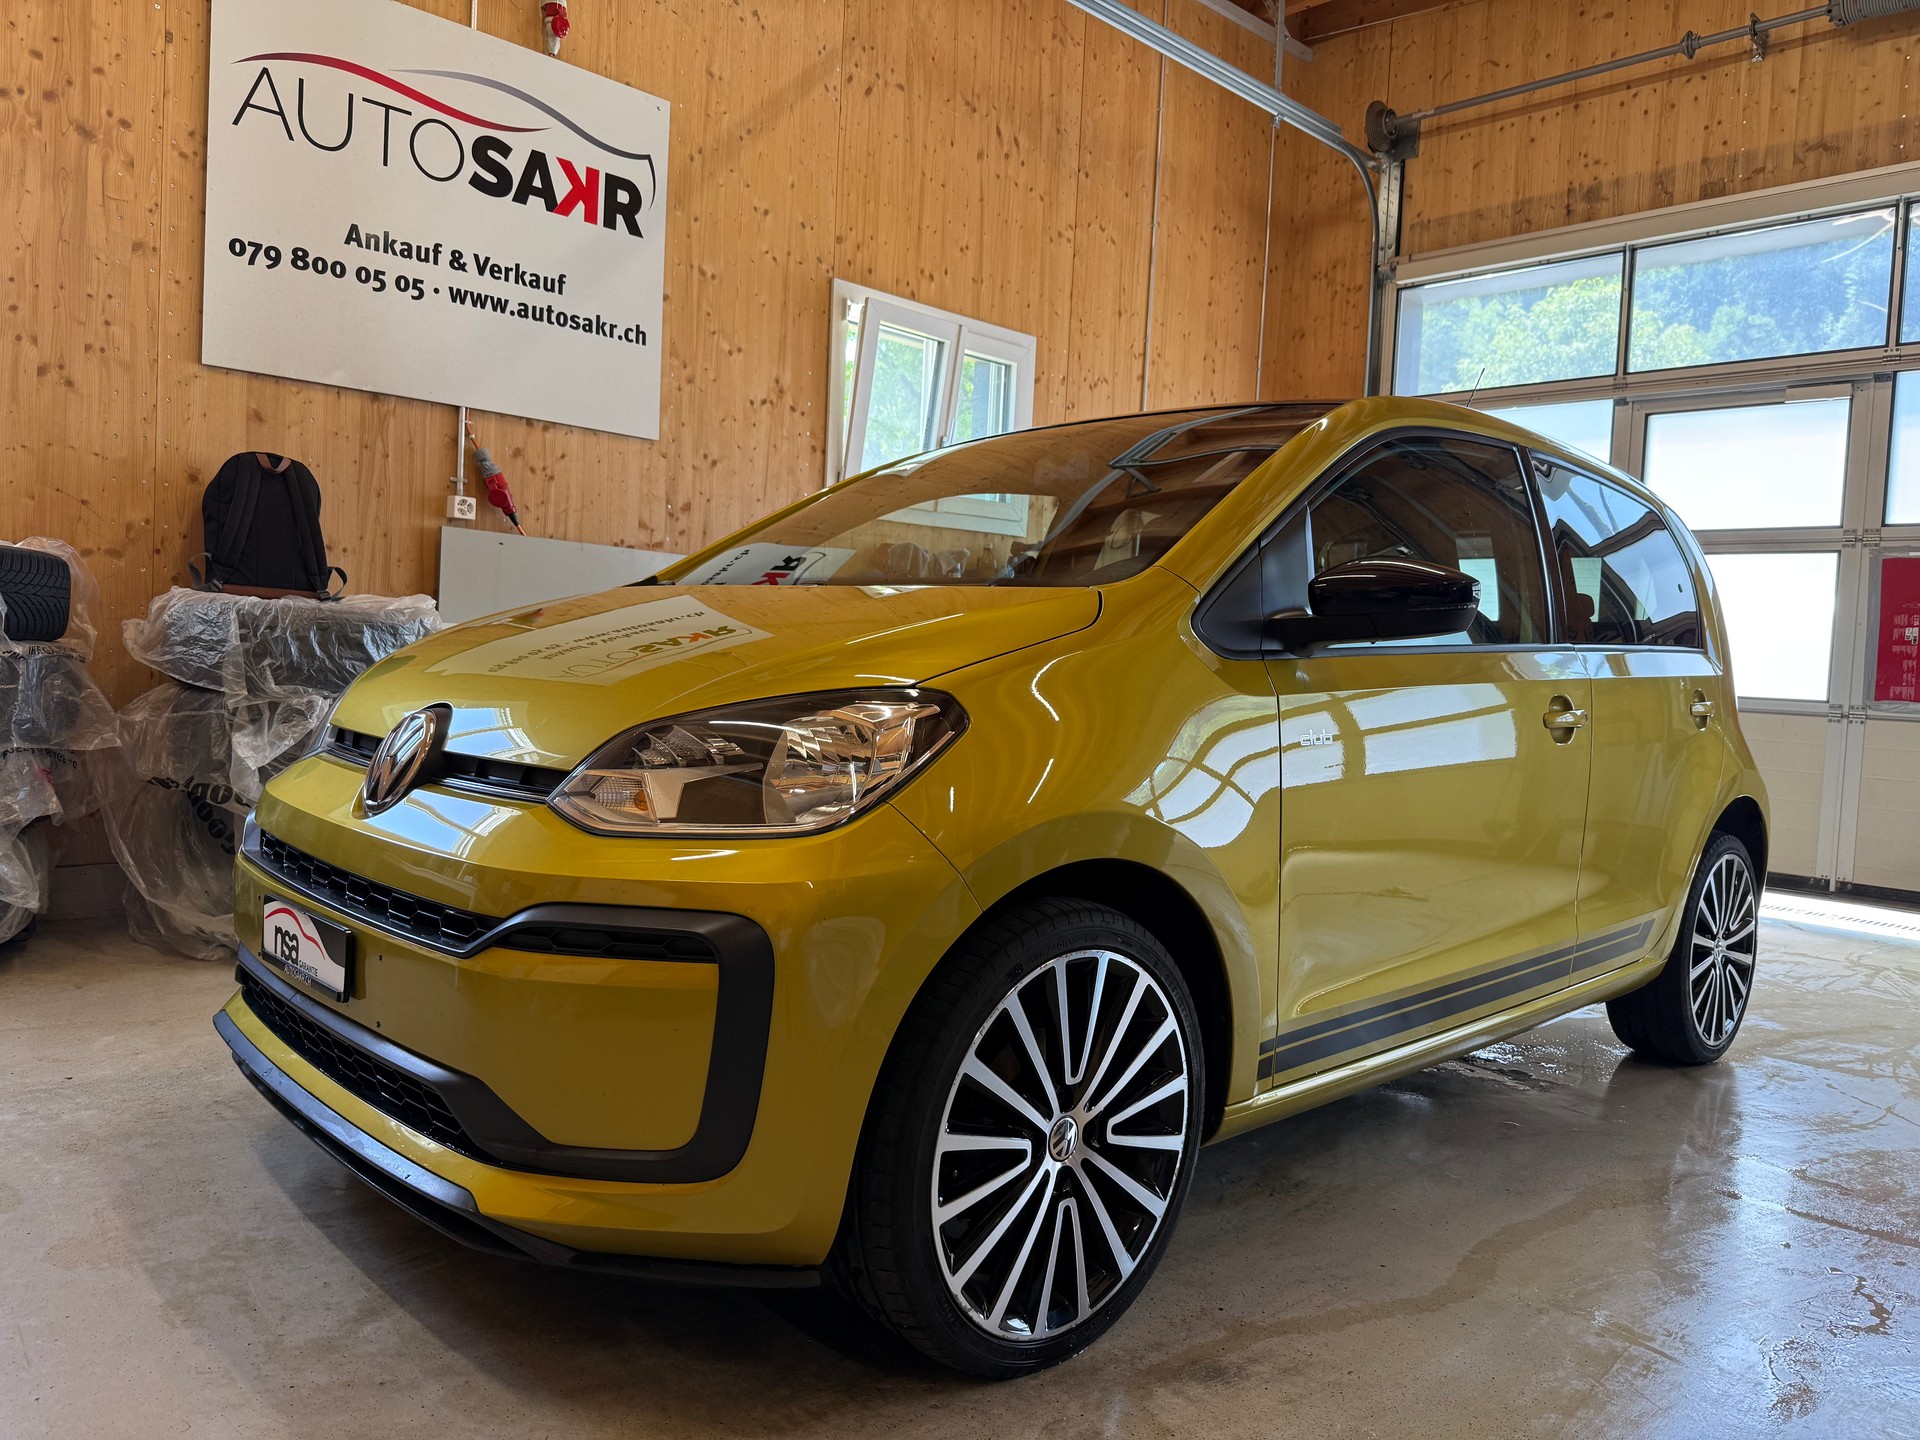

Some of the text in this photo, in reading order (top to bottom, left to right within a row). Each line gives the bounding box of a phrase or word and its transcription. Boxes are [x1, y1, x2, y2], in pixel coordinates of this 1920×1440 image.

[343, 223, 567, 296] Ankauf & Verkauf
[228, 237, 647, 346] 079 800 05 05 www.autosakr.ch
[1300, 729, 1333, 746] club
[274, 925, 299, 966] nsa
